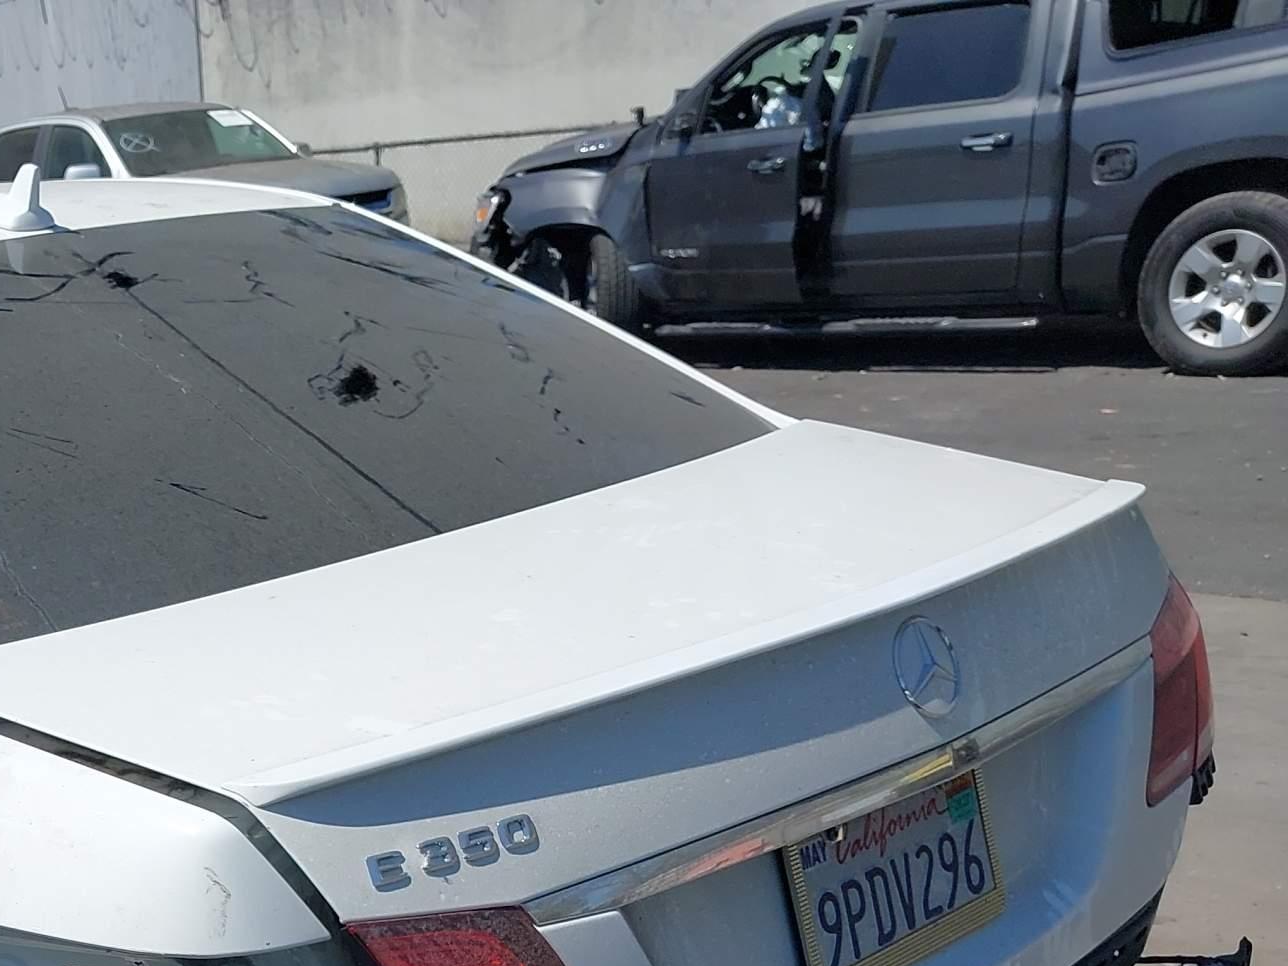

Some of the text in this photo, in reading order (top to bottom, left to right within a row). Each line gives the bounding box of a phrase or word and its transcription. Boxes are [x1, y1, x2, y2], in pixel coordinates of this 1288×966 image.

[365, 813, 540, 893] E 350
[800, 838, 827, 871] MAY
[835, 796, 948, 865] California
